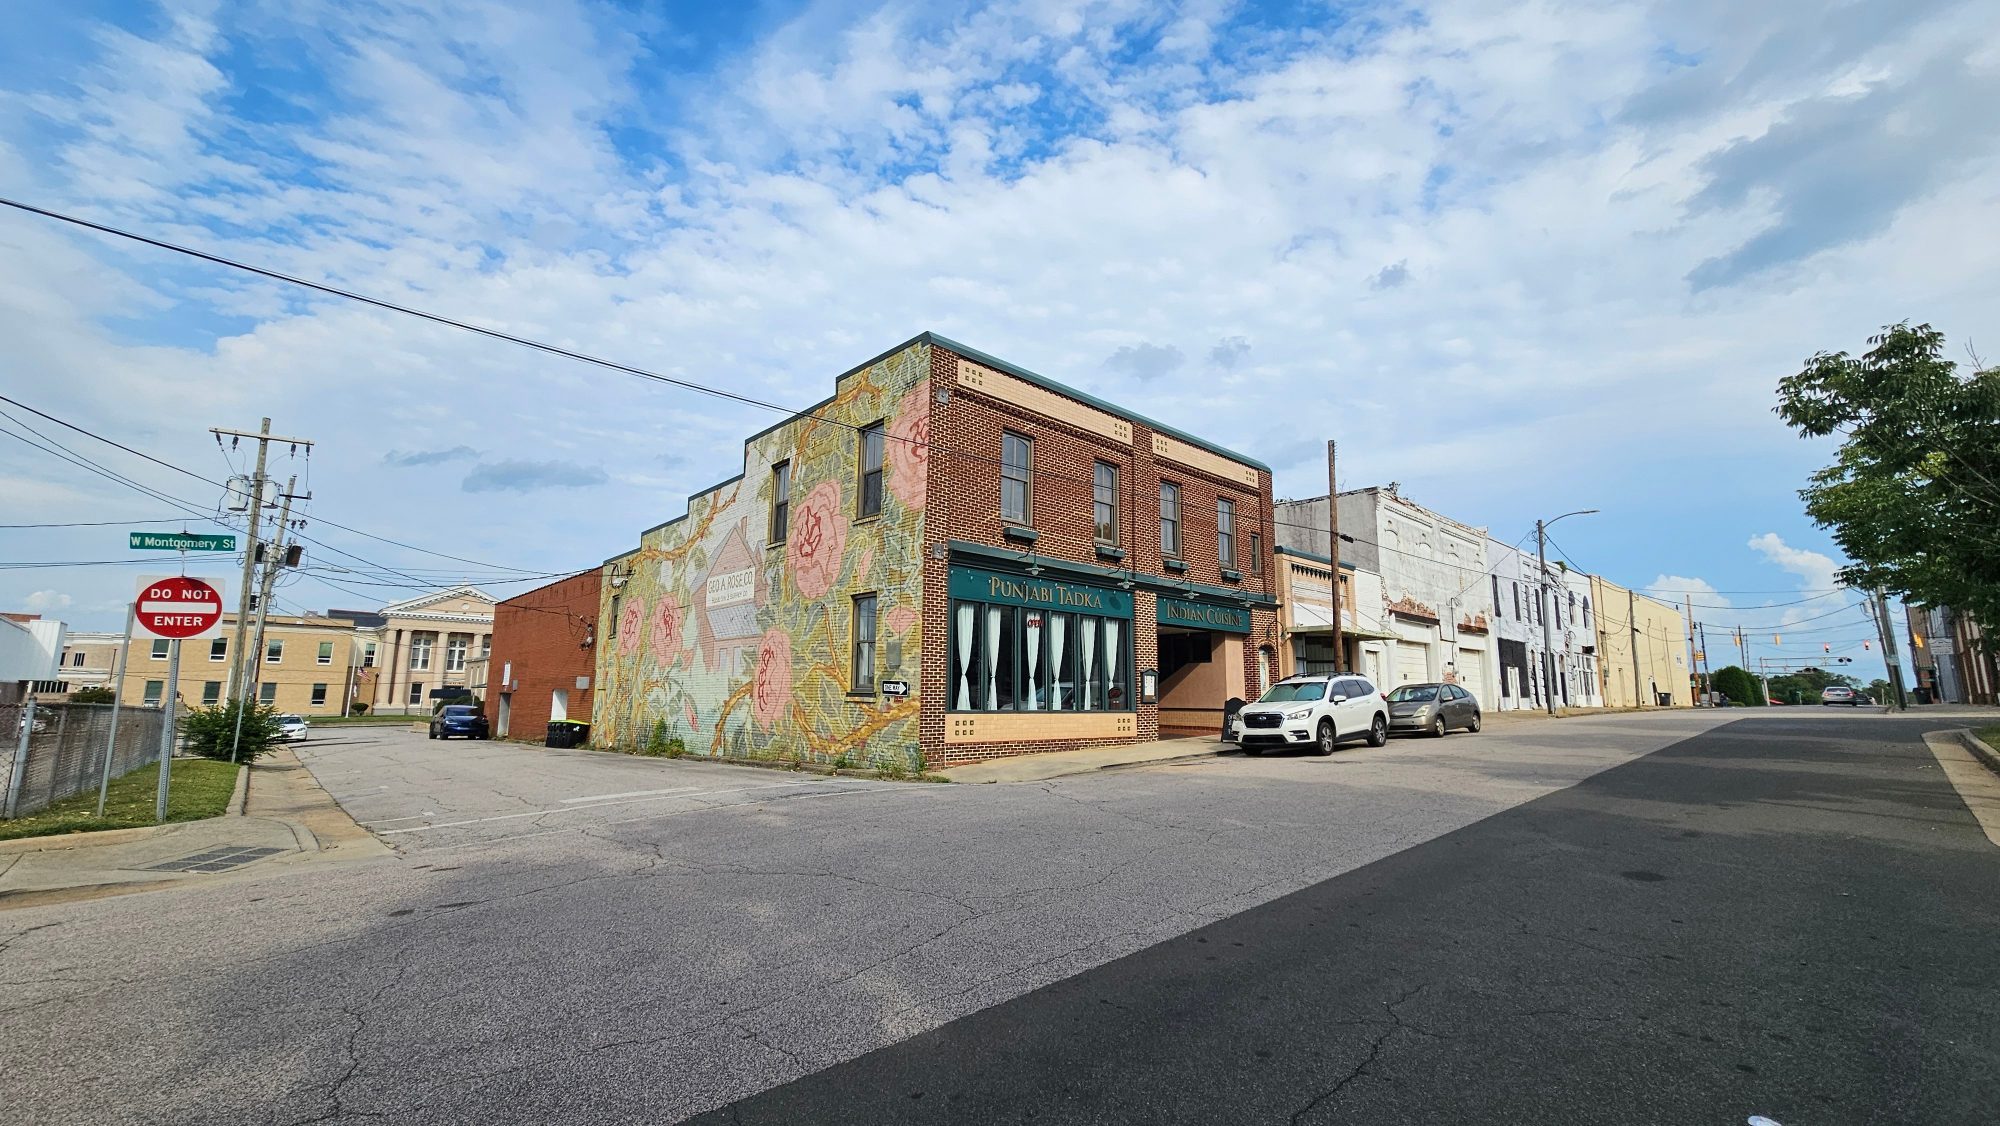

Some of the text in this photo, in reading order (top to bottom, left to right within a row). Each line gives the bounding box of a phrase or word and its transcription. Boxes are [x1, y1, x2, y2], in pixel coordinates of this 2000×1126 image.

[131, 536, 235, 549] W Montgomery St
[151, 589, 211, 599] DO NOT
[154, 616, 203, 626] ENTER
